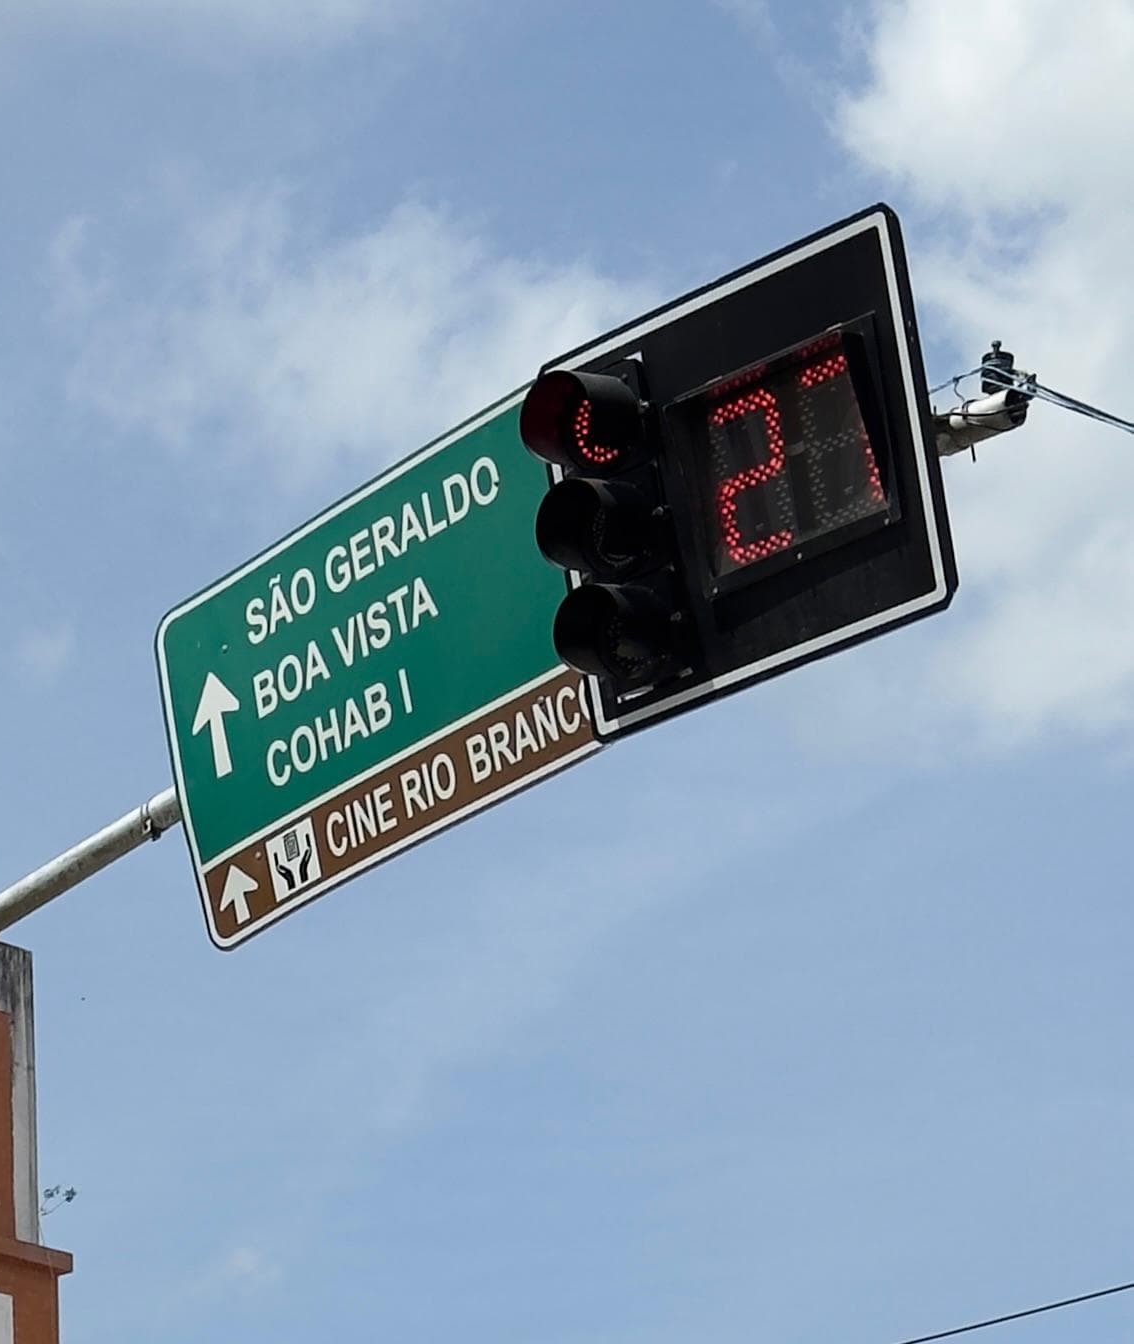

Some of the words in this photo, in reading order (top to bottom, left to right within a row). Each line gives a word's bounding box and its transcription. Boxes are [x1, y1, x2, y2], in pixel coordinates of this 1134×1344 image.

[244, 566, 317, 647] SÃO
[324, 456, 500, 592] GERALDO
[252, 644, 328, 720] BOA
[333, 576, 439, 671] VISTA
[265, 689, 394, 788] COHAB
[325, 778, 398, 858] CINE
[403, 750, 458, 820] RIO
